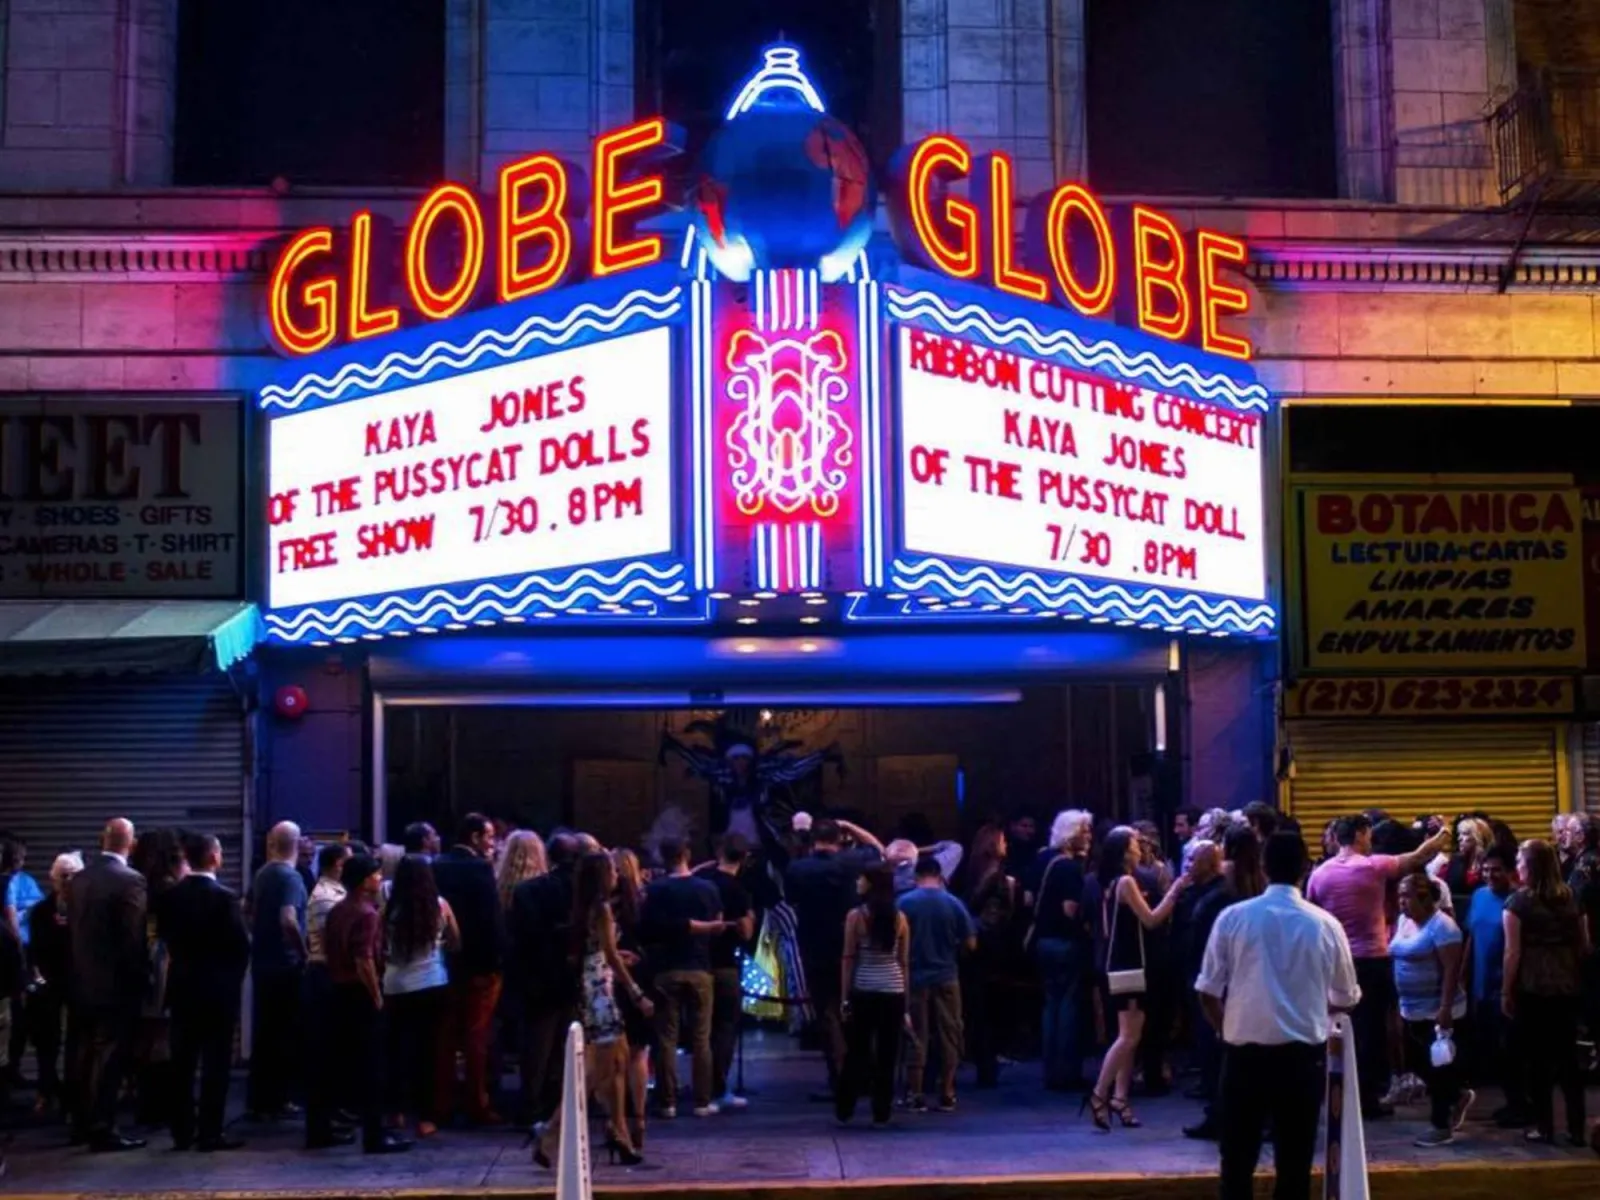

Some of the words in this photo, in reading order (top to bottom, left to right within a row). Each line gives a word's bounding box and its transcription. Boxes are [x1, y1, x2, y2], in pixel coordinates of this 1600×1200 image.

[269, 117, 663, 354] GLOBE
[907, 134, 1251, 361] GLOBE
[364, 410, 437, 456] KAYA
[480, 375, 585, 433] JONES
[909, 328, 1020, 394] RIBBON
[1029, 361, 1144, 422] CUTTING
[1154, 393, 1260, 449] CONCERT
[0, 415, 201, 500] EET
[266, 489, 301, 525] OF
[311, 476, 362, 517] THE
[374, 444, 523, 505] PUSSYCAT
[539, 418, 651, 475] DOLLS
[1004, 408, 1078, 458] KAYA
[1103, 433, 1187, 479] JONES
[35, 505, 120, 526] SHOES
[140, 505, 212, 525] GIFTS
[277, 531, 338, 573] FREE
[357, 514, 435, 559] SHOW
[469, 497, 538, 542] 7/30
[568, 477, 643, 525] 8PM
[910, 445, 949, 485] OF
[964, 455, 1022, 500] THE
[1039, 468, 1168, 525] PUSSYCAT
[1185, 498, 1245, 540] DOLL
[1317, 493, 1573, 534] BOTANICA
[26, 562, 126, 582] WHOLE
[146, 561, 213, 581] SALE
[1047, 523, 1111, 566] 7/30
[1369, 568, 1512, 591] LIMPIAS
[1300, 677, 1385, 714] (213)
[1390, 678, 1563, 709] 623-2324
